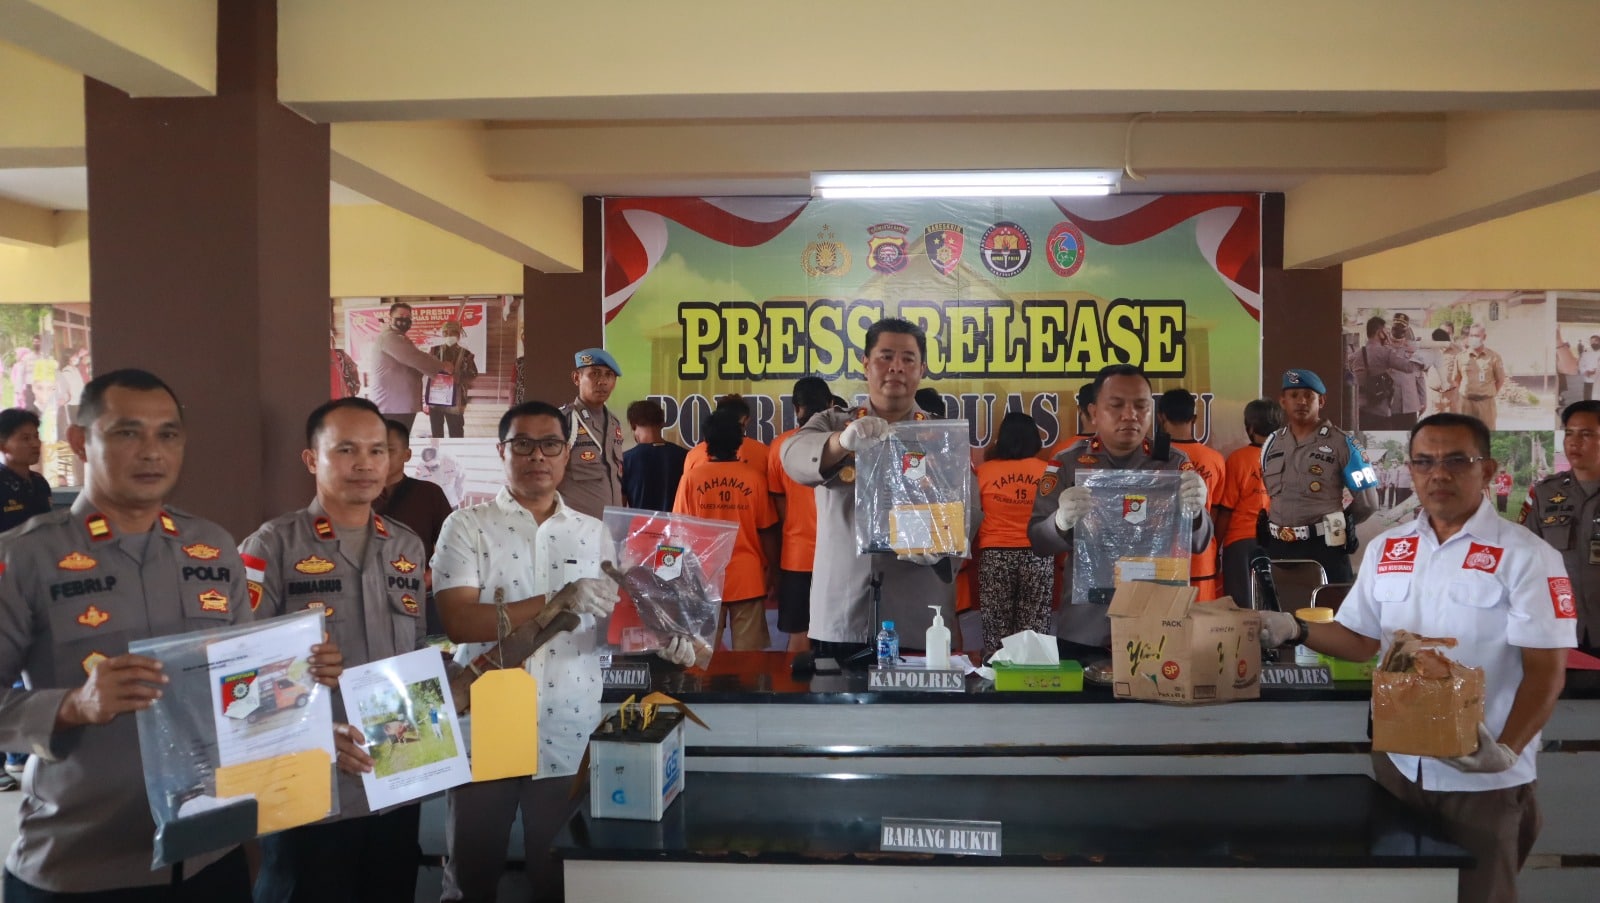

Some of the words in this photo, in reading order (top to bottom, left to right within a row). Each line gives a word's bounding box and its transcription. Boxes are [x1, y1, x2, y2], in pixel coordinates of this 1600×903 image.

[679, 301, 882, 380] PRESS
[898, 298, 1185, 379] RELEASE
[697, 477, 752, 496] TAHANAN
[993, 473, 1045, 490] TAHANA
[719, 490, 731, 501] 10
[1015, 488, 1027, 500] 15
[1162, 620, 1182, 628] PACK
[602, 670, 646, 685] ESKRIM
[1164, 665, 1178, 675] SP
[870, 671, 962, 688] KAPOLRES
[883, 826, 945, 849] BARANG
[949, 829, 998, 851] BUKTI
